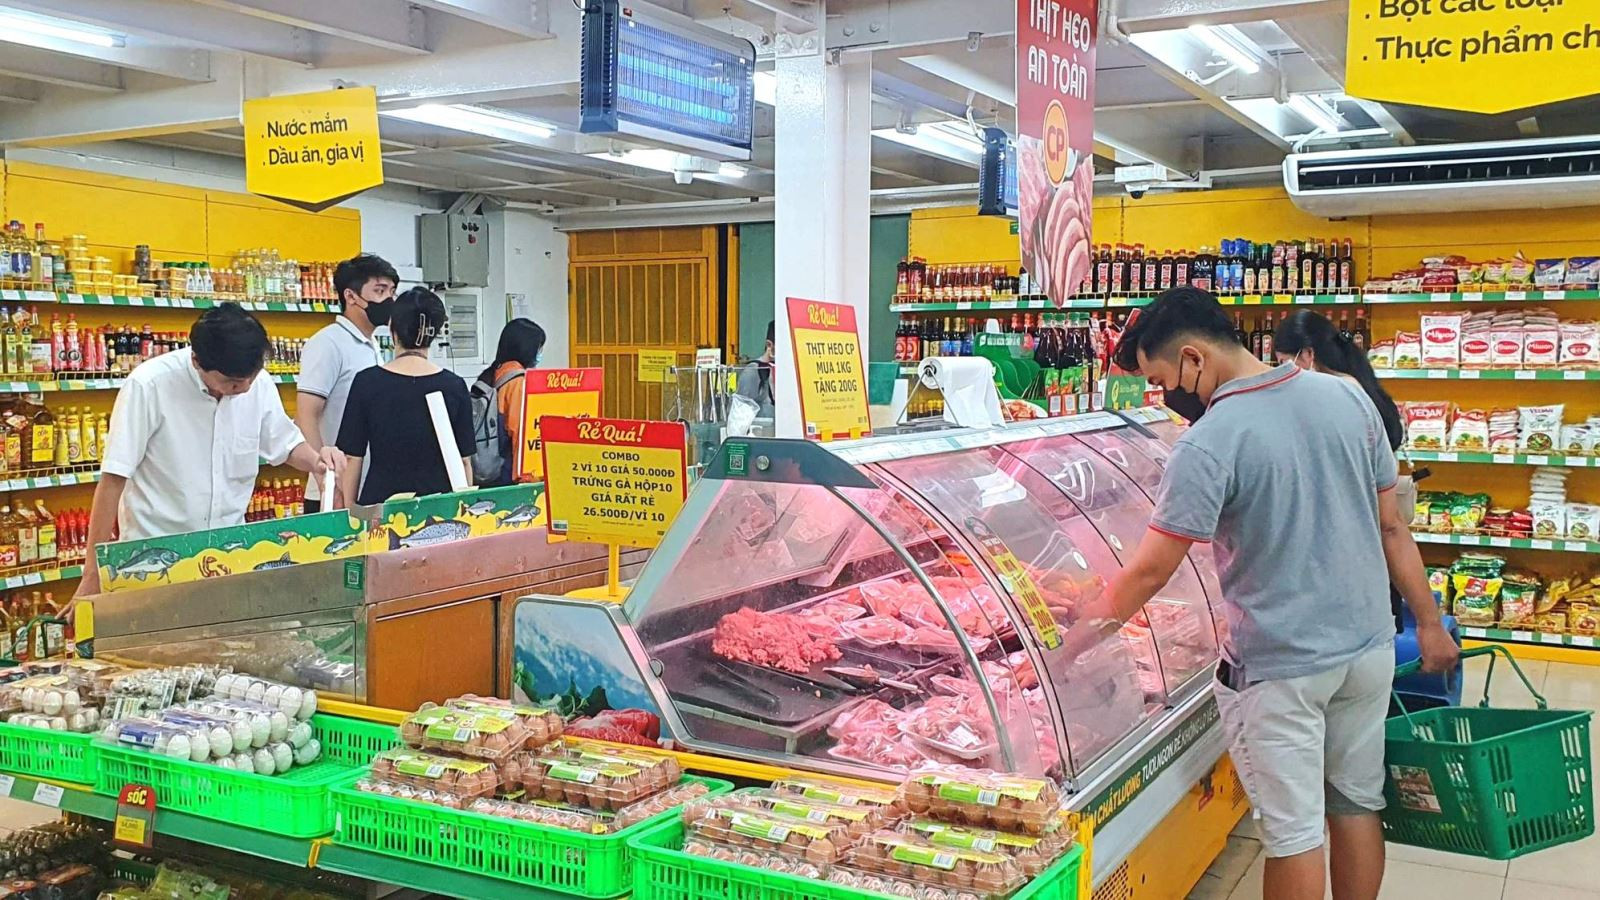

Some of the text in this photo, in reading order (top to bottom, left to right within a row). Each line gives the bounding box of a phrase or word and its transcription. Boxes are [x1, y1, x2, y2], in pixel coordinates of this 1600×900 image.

[1029, 0, 1090, 52] THỊT HEO
[1376, 36, 1453, 64] Thực
[1460, 25, 1553, 62] phẩm
[1028, 45, 1087, 101] AN TOÀN
[267, 112, 348, 138] Nước mắm
[268, 140, 364, 166] Dầu ăn, gia vị
[1046, 125, 1065, 162] CP
[807, 303, 820, 324] Rẻ
[806, 342, 855, 358] THỊT HEO CP
[816, 361, 852, 374] MUA 1KG
[547, 371, 584, 390] Rẻ Quá!
[813, 377, 857, 397] TẶNG 200G
[1409, 408, 1443, 417] VEDAN
[577, 421, 646, 444] Rẻ Quá!
[601, 451, 640, 461] COMBO
[572, 463, 578, 471] 2
[596, 465, 608, 473] 10
[632, 467, 676, 478] 50.000Đ
[572, 475, 612, 488] TRỨNG
[591, 491, 612, 503] GIÁ
[615, 492, 637, 504] RẤT
[651, 512, 665, 522] 10
